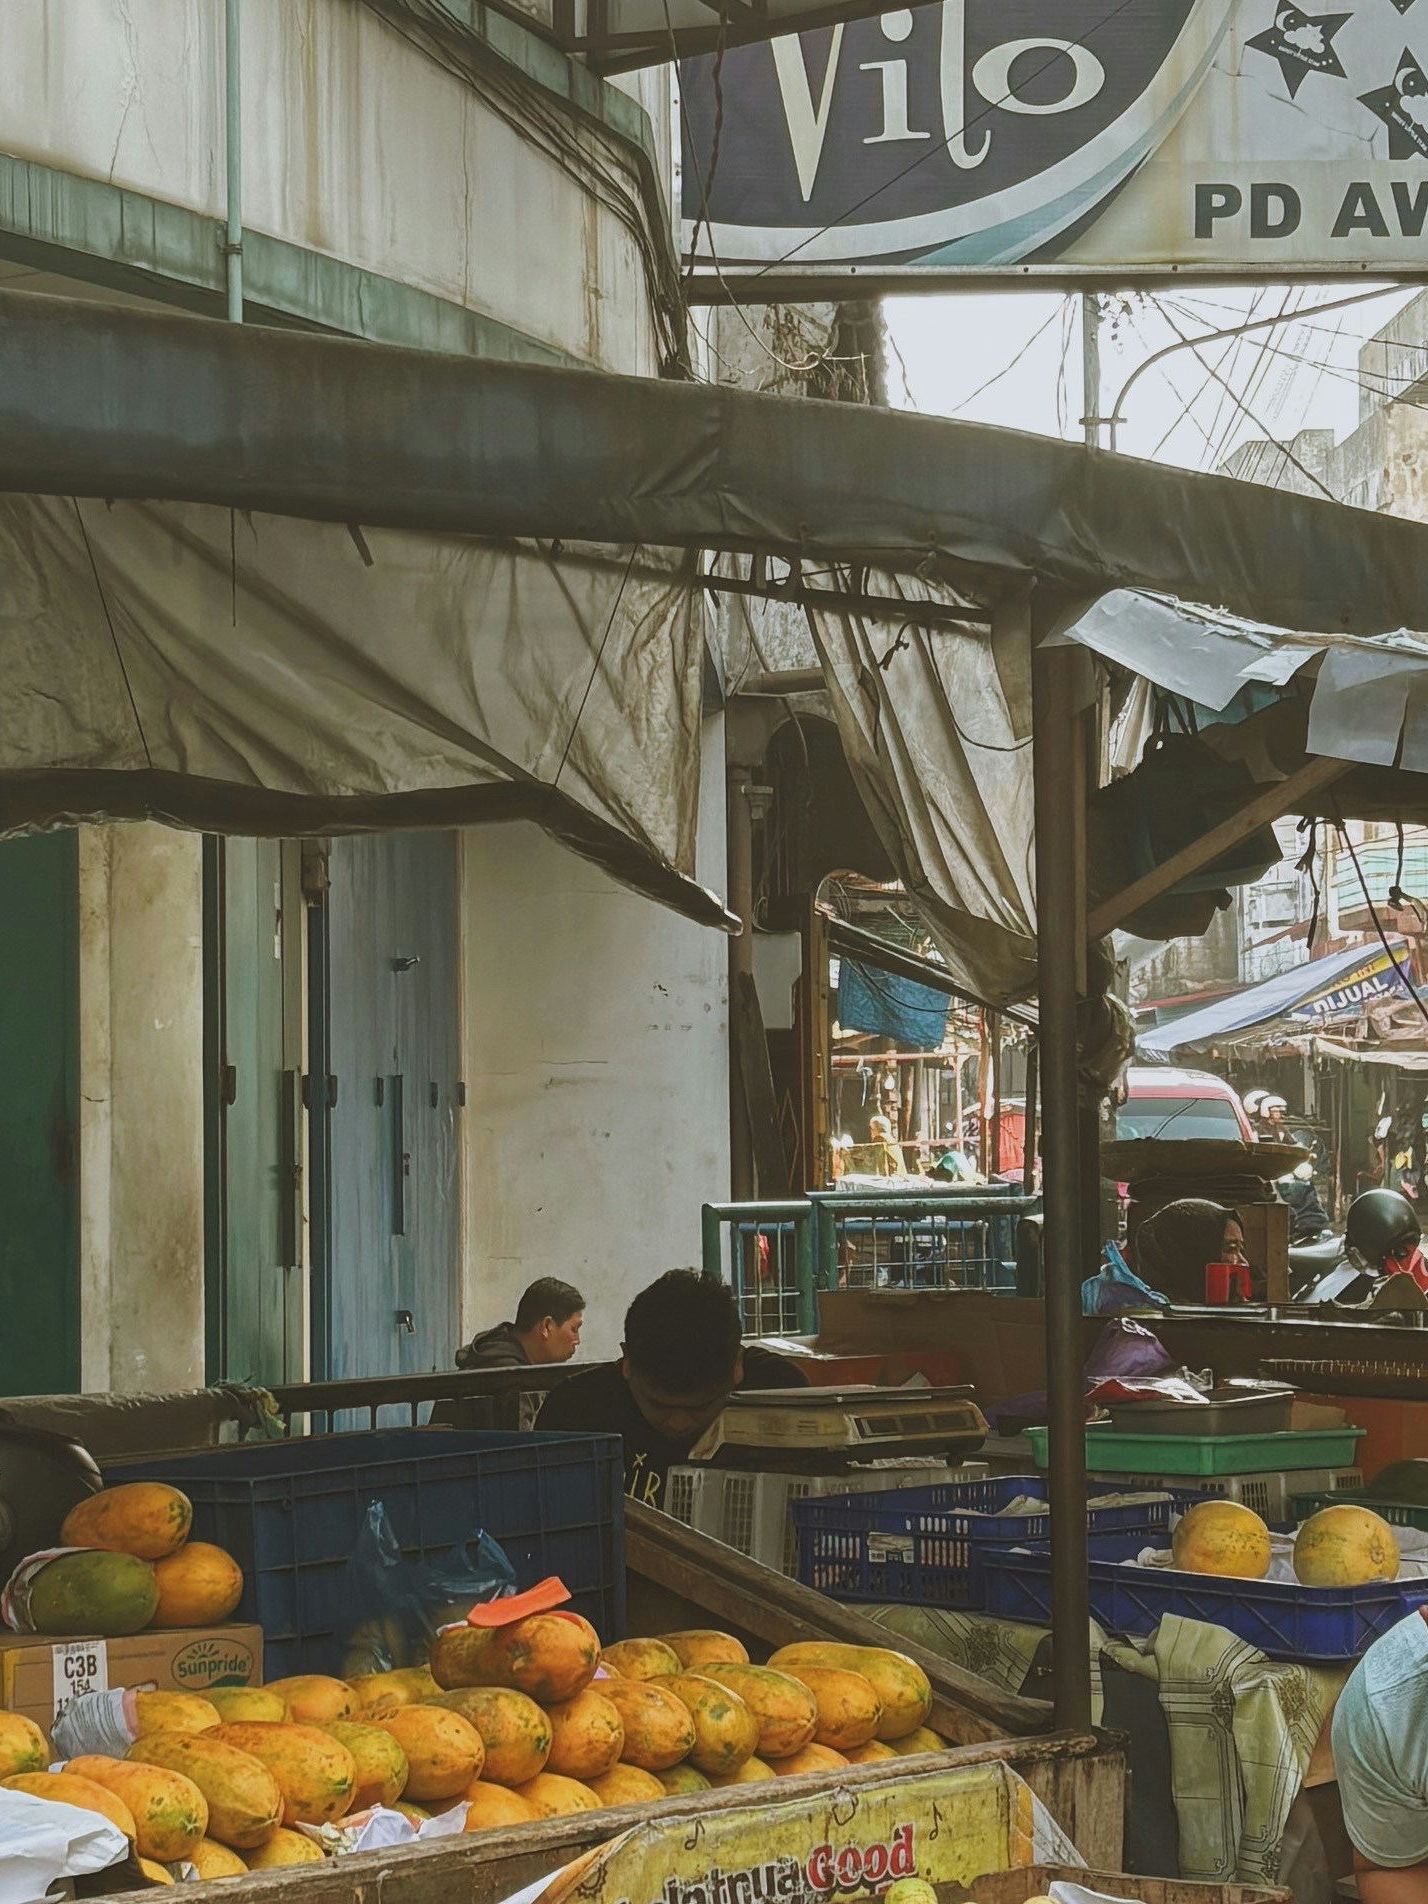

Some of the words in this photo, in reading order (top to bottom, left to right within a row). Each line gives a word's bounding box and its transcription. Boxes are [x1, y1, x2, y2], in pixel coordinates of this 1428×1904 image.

[1194, 183, 1301, 239] PD
[1313, 976, 1389, 1014] DIJUAL
[64, 1654, 97, 1679] C3B
[177, 1654, 247, 1680] Sunpride
[805, 1823, 916, 1893] Good
